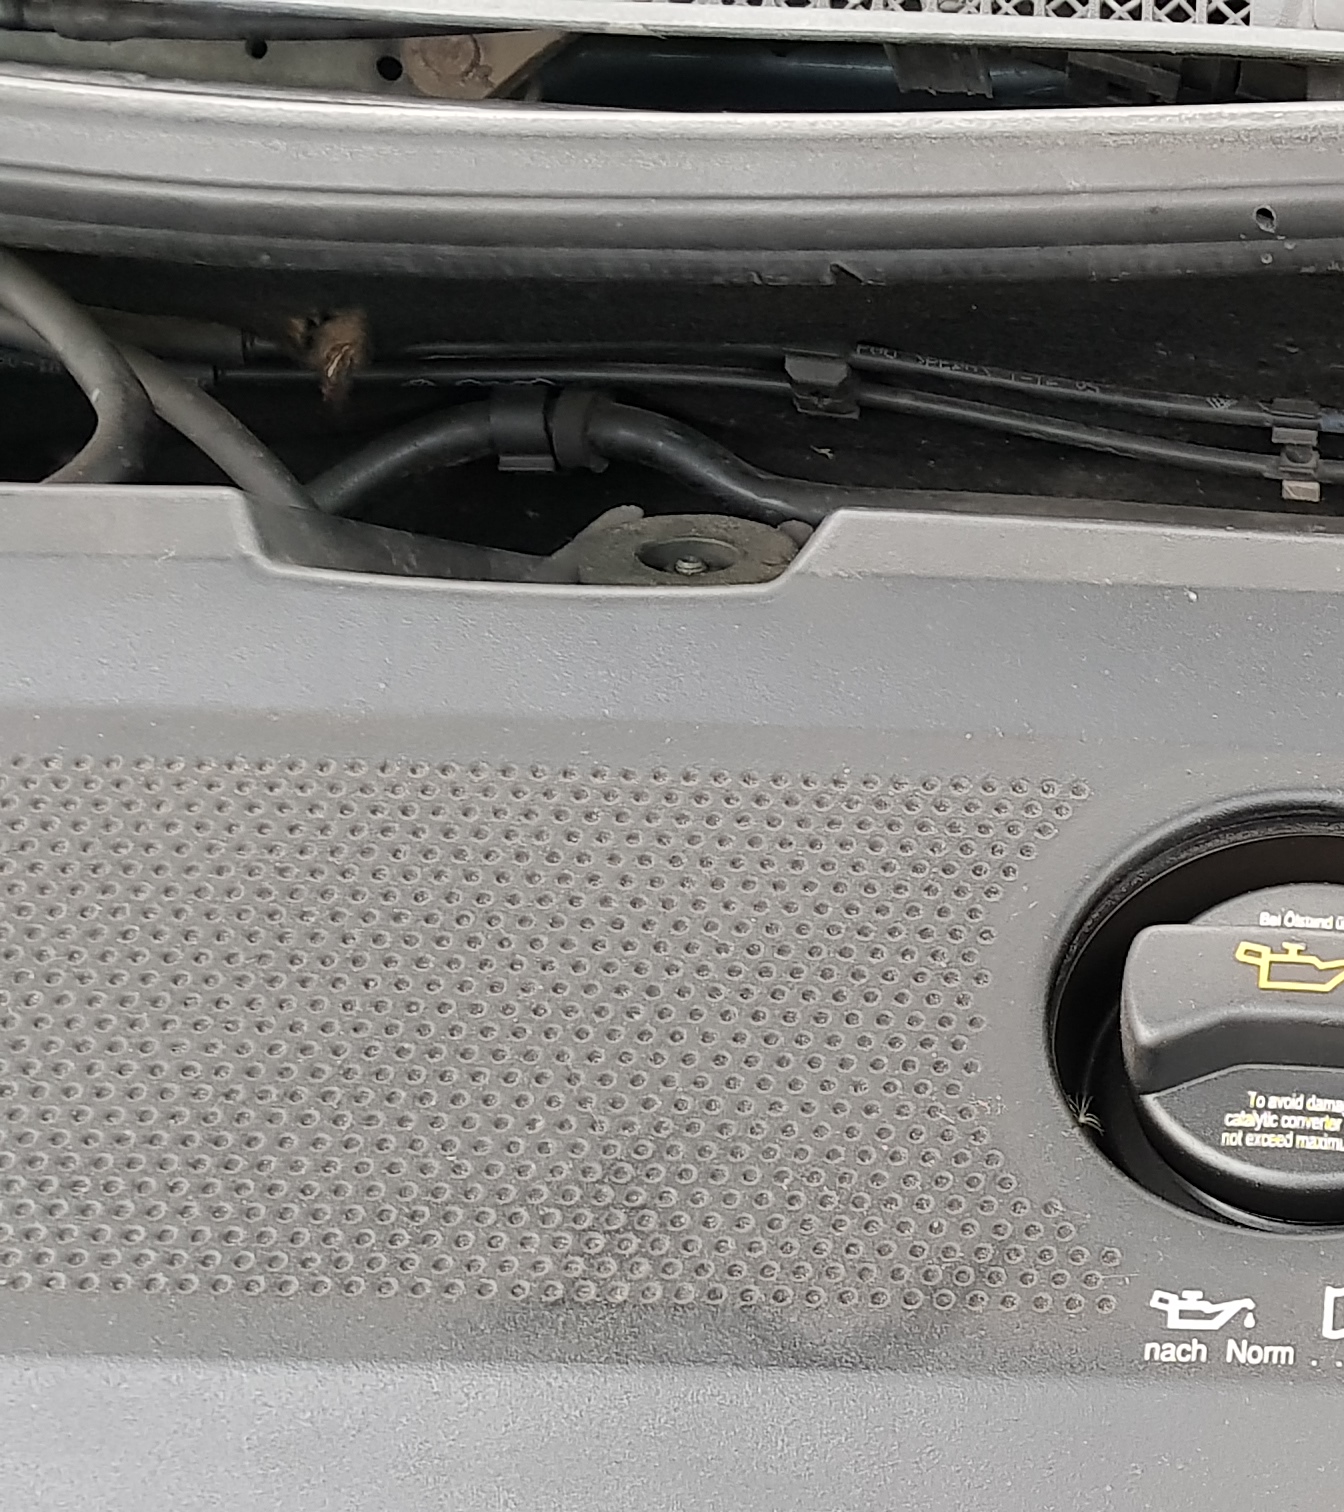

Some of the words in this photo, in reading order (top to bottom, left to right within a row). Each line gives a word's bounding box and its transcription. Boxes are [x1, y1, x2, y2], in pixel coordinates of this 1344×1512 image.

[1259, 911, 1282, 927] Bei
[1247, 1091, 1266, 1109] To
[1267, 1093, 1305, 1111] avoid
[1223, 1110, 1279, 1131] catalytic
[1280, 1114, 1343, 1132] converter
[1221, 1131, 1243, 1147] not
[1245, 1131, 1294, 1149] exceed
[1143, 1337, 1208, 1363] nach
[1225, 1338, 1295, 1366] Norm
